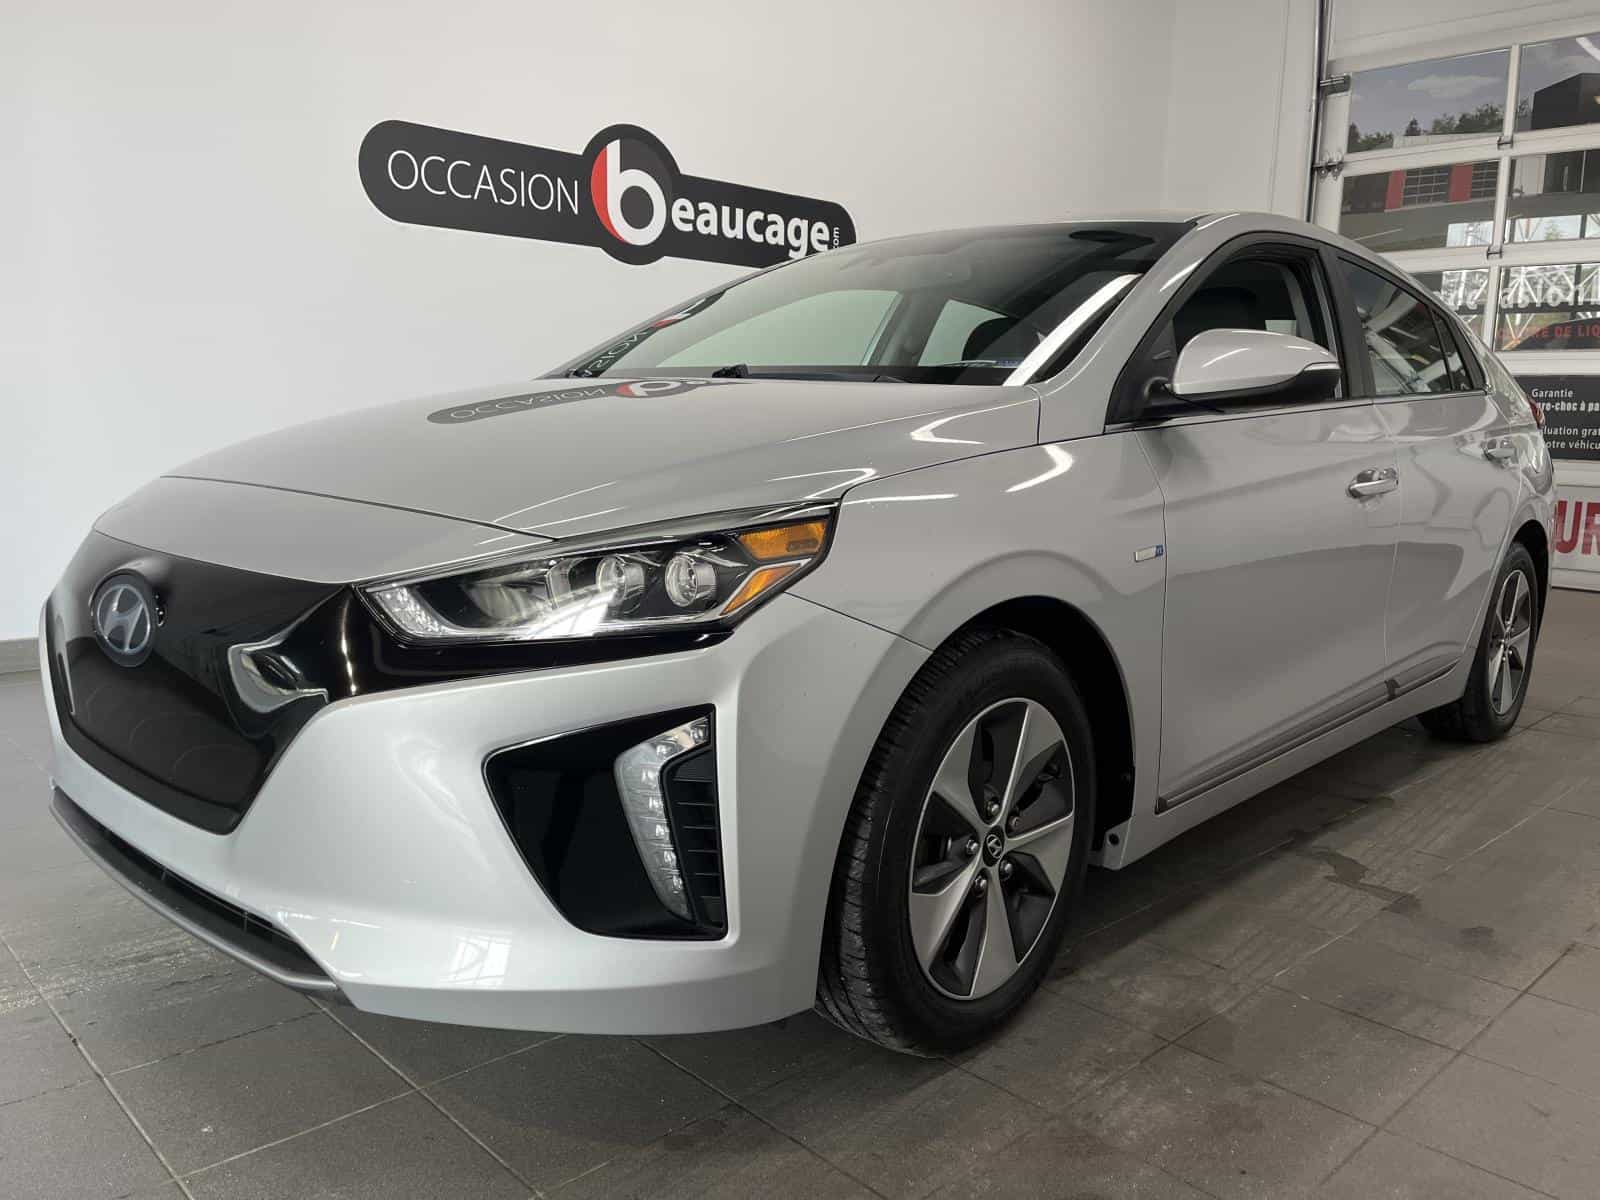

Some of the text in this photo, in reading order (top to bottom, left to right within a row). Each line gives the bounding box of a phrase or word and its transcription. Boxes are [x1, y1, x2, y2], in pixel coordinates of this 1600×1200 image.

[387, 149, 579, 215] OCCASION
[1531, 388, 1574, 398] Garantie
[1543, 425, 1579, 435] luation
[1544, 440, 1566, 449] otre
